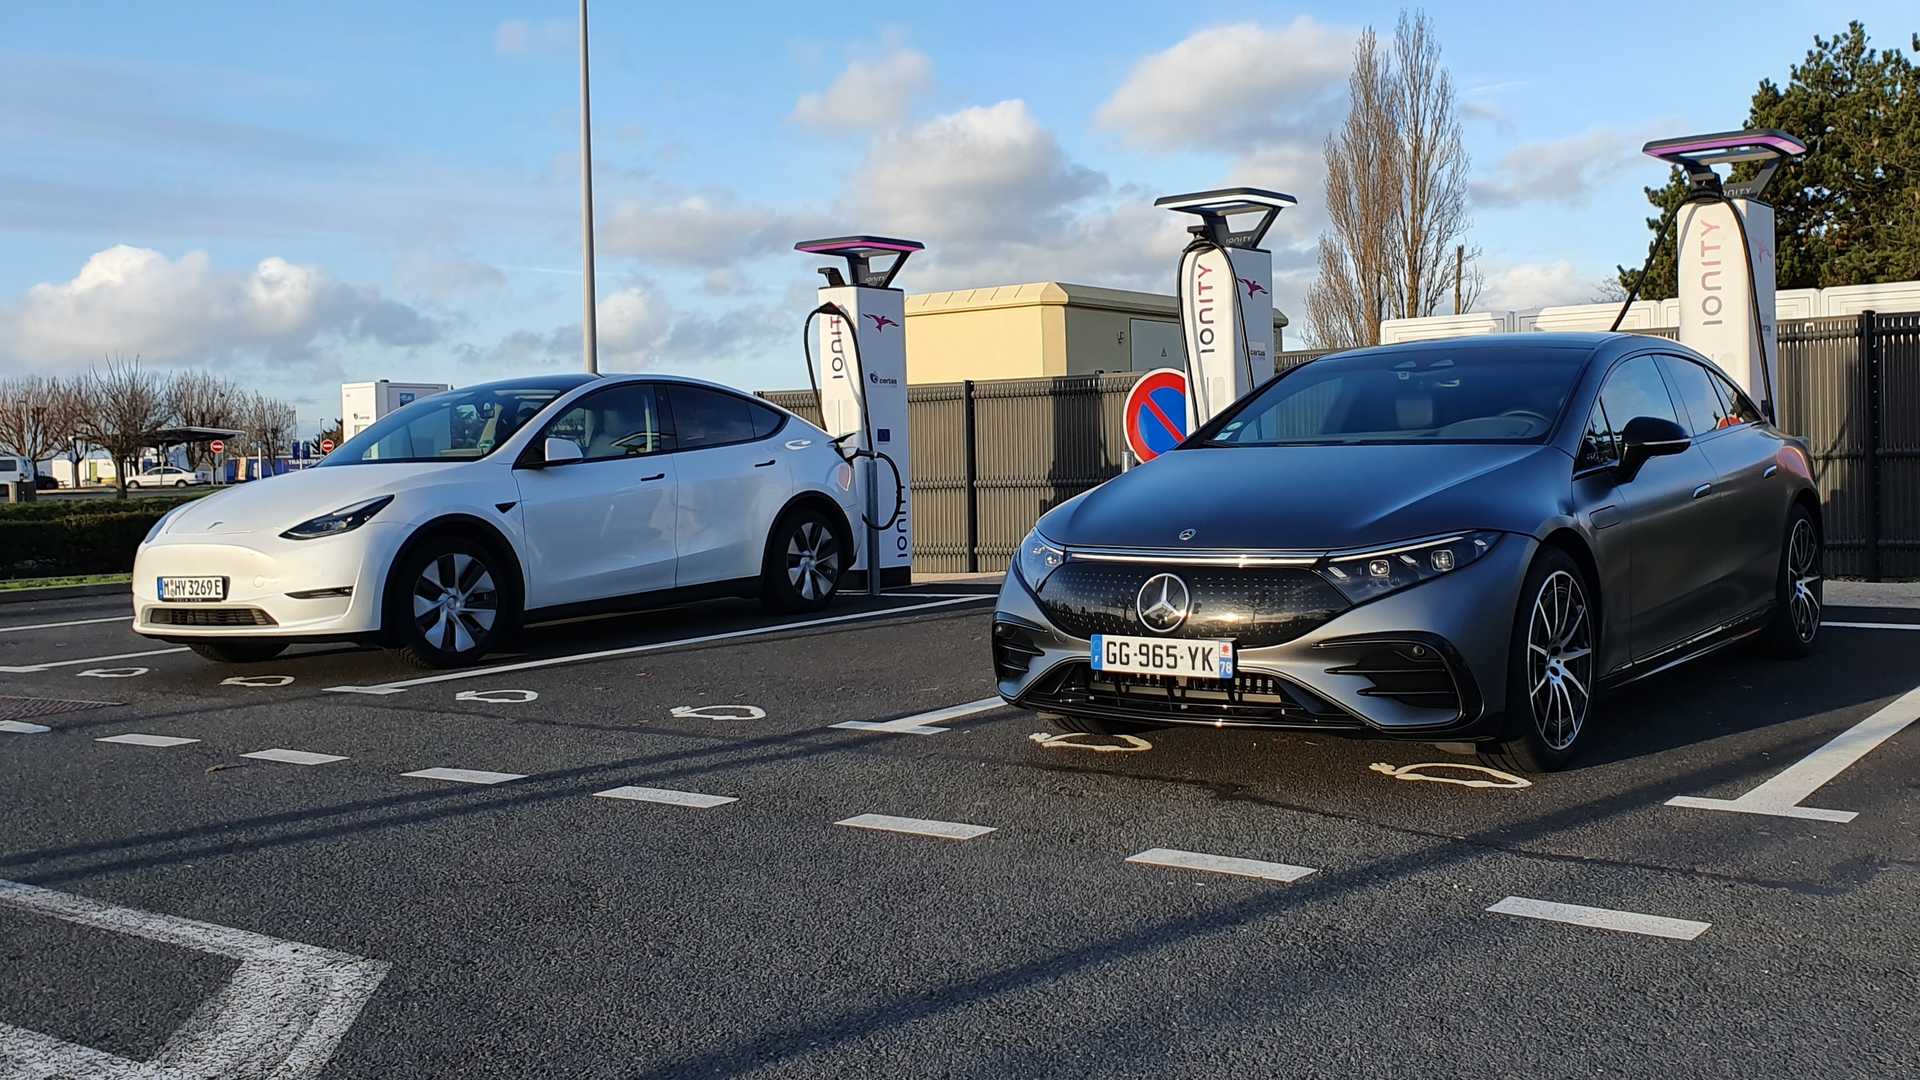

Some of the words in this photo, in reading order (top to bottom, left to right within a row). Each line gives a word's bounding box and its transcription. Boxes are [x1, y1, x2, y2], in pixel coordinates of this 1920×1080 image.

[1198, 264, 1215, 353] IONITY
[831, 315, 844, 378] IONIT
[188, 580, 212, 595] 3269
[215, 580, 221, 595] E
[1106, 641, 1214, 672] GG-965-YK
[1220, 661, 1232, 673] 78
